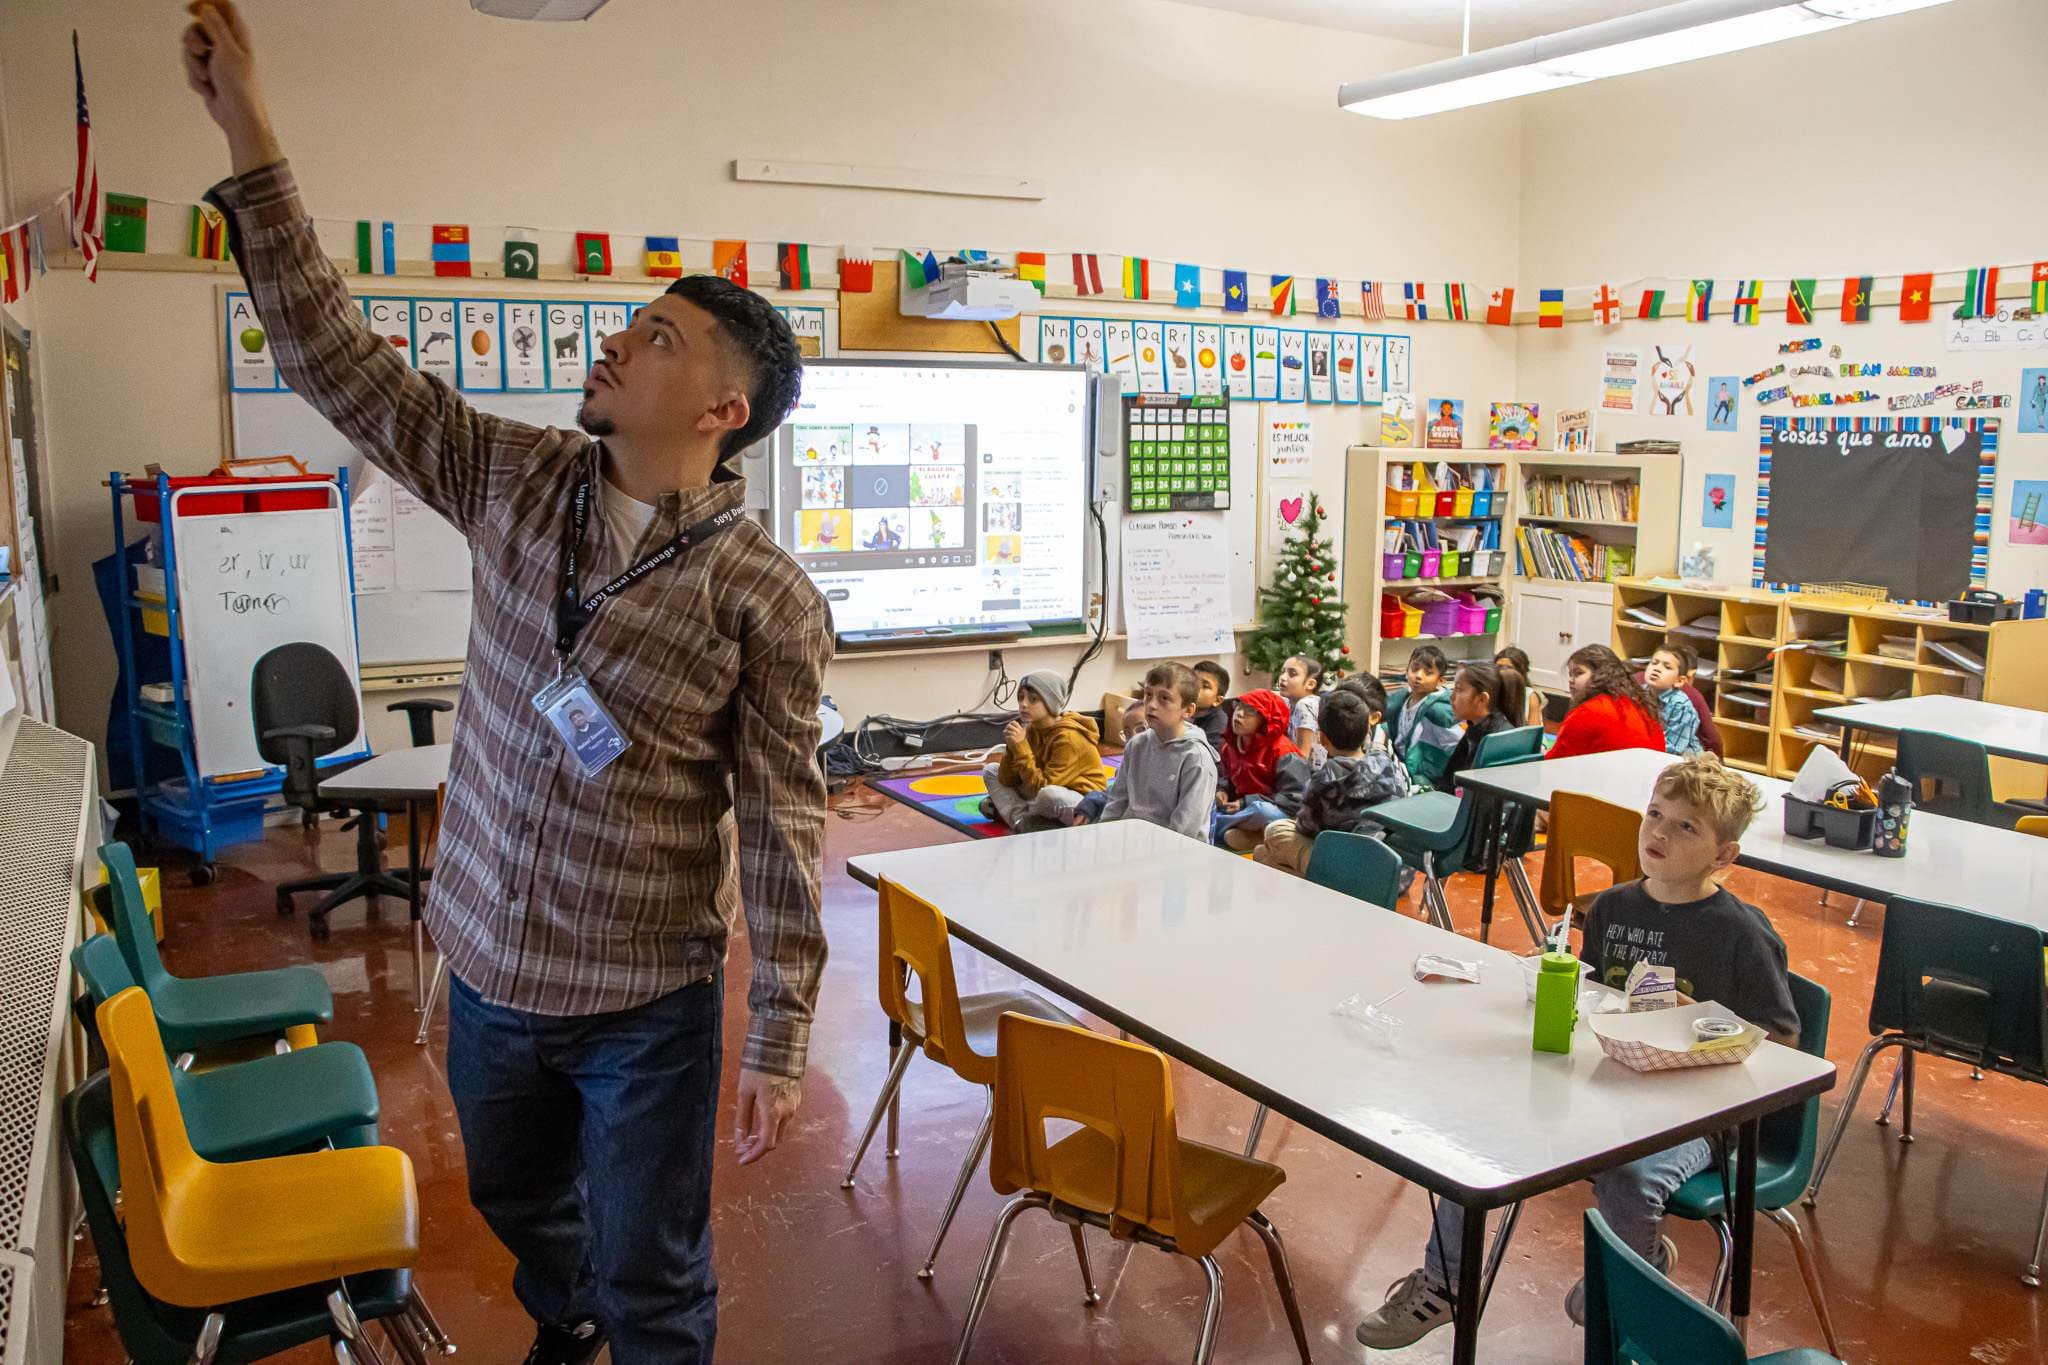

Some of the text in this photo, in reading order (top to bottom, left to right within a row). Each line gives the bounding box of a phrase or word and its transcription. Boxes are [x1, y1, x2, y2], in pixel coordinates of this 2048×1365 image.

[234, 303, 249, 319] A
[1840, 363, 1881, 377] DILAN
[1284, 433, 1310, 442] MEJOR
[1779, 430, 1932, 456] cosas que amo
[585, 546, 675, 612] 509J Dual Language
[1628, 928, 1644, 944] WHO
[1647, 931, 1664, 947] ATE
[1613, 944, 1628, 960] THE
